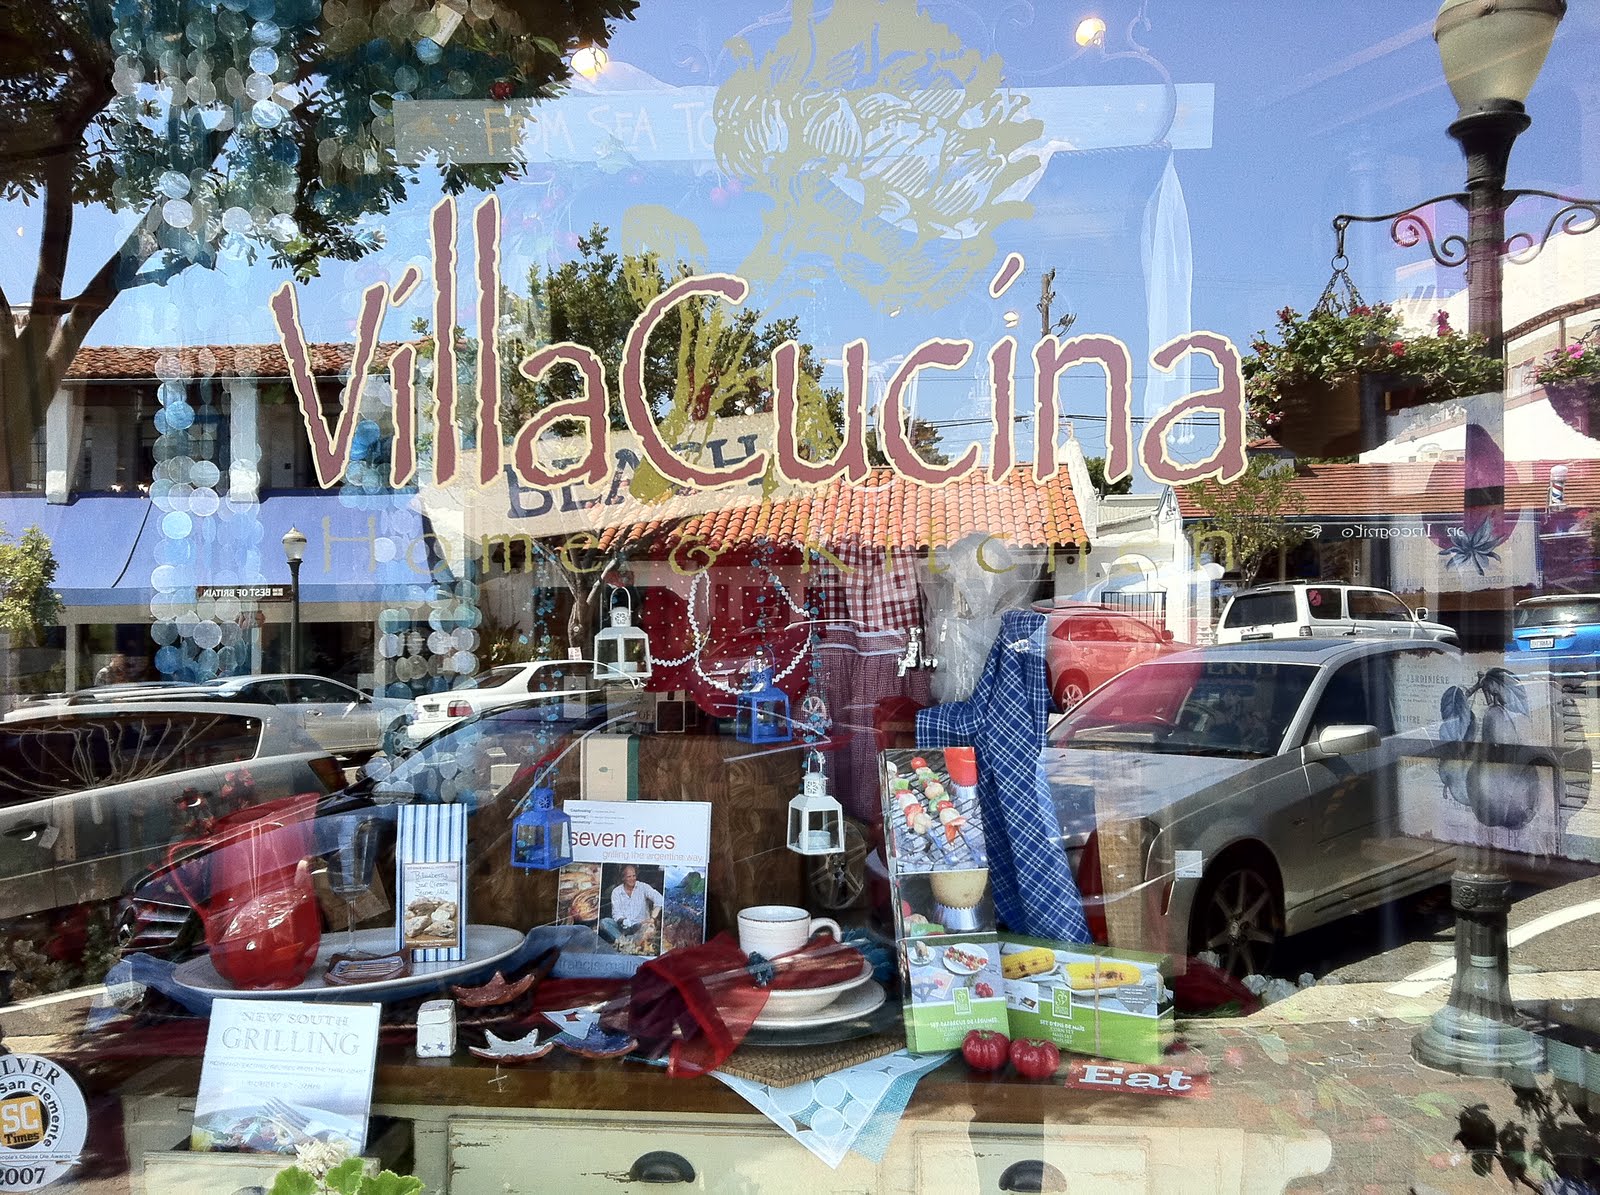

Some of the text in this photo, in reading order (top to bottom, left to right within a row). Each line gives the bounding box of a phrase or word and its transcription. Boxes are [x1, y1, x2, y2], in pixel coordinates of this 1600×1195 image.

[321, 515, 604, 576] Home
[668, 513, 731, 577] &
[571, 829, 675, 850] seven fires
[602, 850, 703, 863] grilling the argentine way
[241, 1011, 350, 1027] NEW SOUTH
[221, 1026, 361, 1057] GRILLING
[0, 1057, 61, 1087] LVER
[1078, 1064, 1193, 1091] Eat
[0, 1080, 61, 1149] San Clemente
[2, 1100, 40, 1134] SC
[4, 1132, 40, 1145] Times
[50, 1152, 71, 1160] Awards
